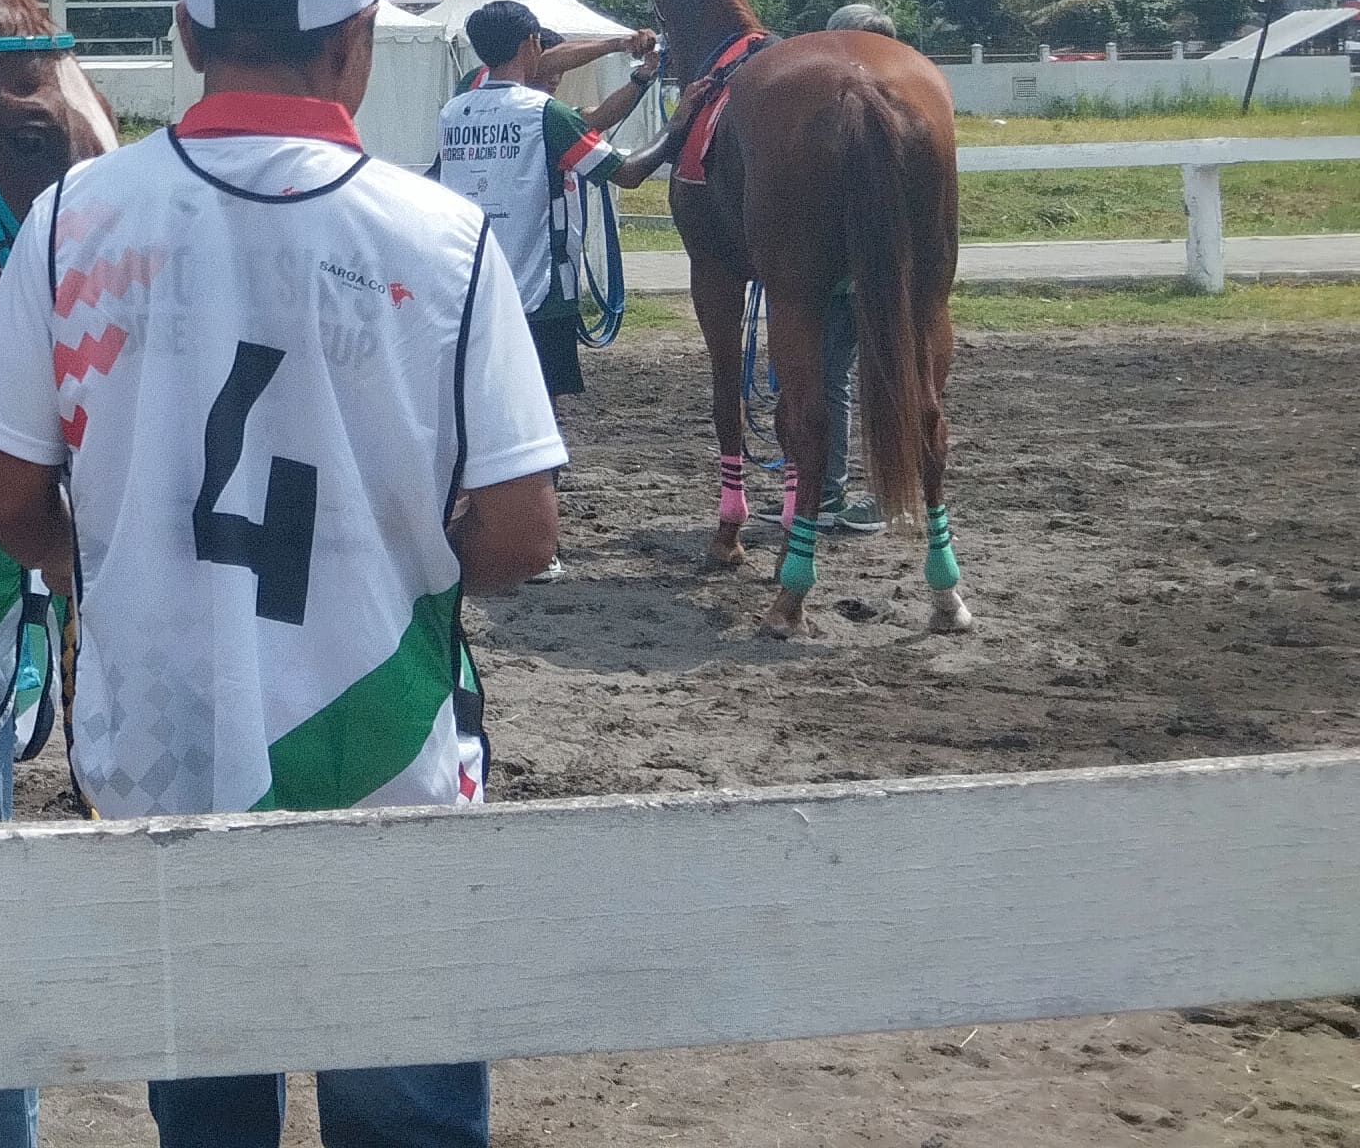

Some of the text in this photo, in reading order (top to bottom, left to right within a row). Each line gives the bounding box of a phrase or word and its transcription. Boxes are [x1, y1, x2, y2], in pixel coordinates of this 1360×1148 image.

[443, 121, 521, 146] INDONESIA'S
[500, 145, 520, 160] CUP
[194, 340, 317, 627] 4
